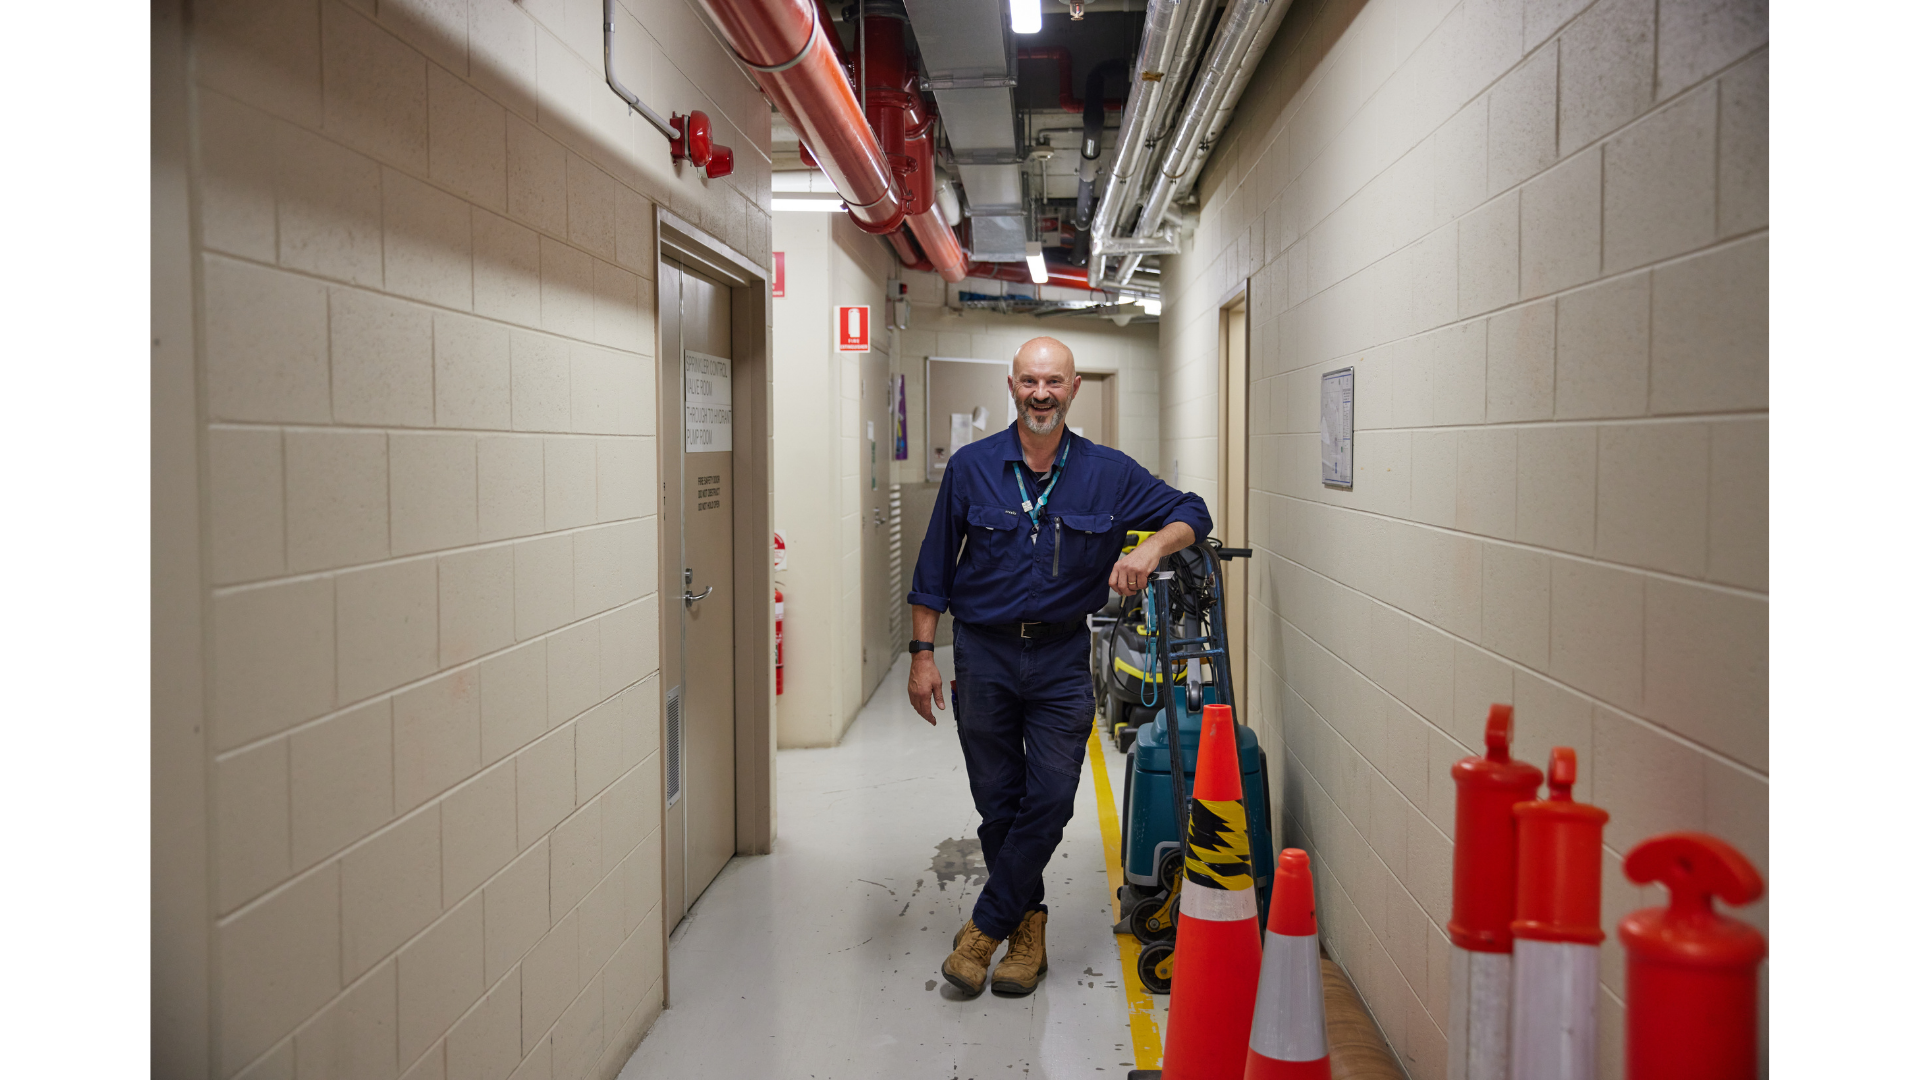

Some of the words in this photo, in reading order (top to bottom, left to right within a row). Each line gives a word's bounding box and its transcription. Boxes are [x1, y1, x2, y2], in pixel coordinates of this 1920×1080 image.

[686, 355, 709, 374] SPRINKLER
[710, 360, 728, 378] CONTROL
[687, 378, 699, 395] VALVE
[700, 379, 712, 396] ROOM
[687, 406, 707, 423] THROUGH
[708, 407, 713, 424] TO
[714, 409, 731, 424] HYDRANT
[687, 429, 699, 445] PUMP
[700, 429, 712, 445] ROOM
[704, 476, 713, 485] SAFETY
[698, 490, 702, 498] DO
[698, 503, 702, 511] DO
